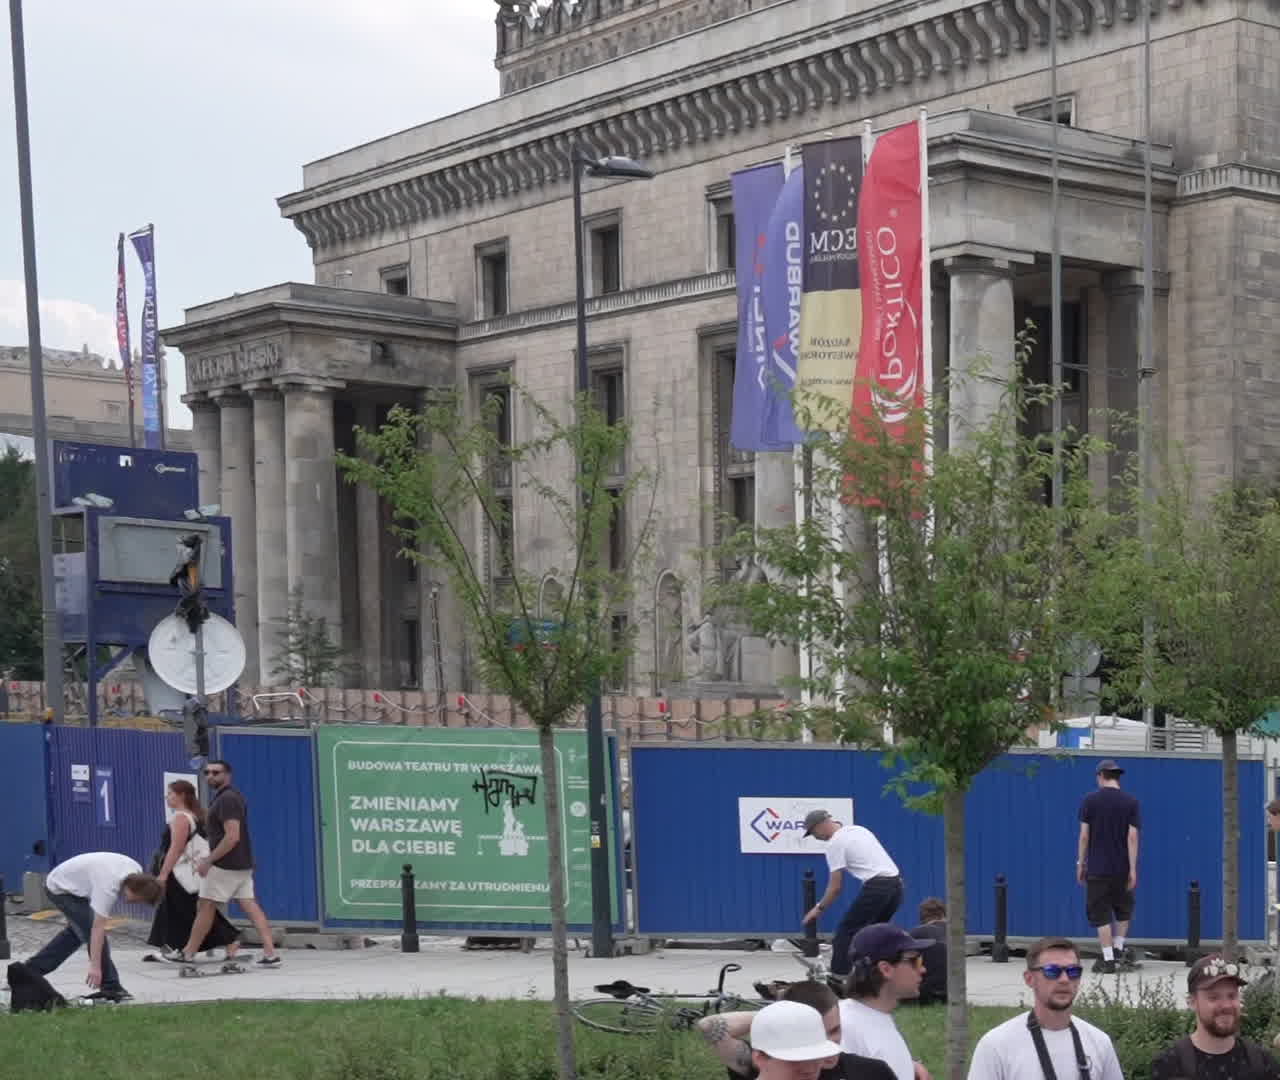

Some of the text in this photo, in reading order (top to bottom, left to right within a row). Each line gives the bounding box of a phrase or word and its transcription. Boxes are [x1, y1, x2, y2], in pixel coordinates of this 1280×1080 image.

[348, 760, 402, 772] BUDOWA
[403, 762, 450, 774] TEATRU
[453, 764, 468, 774] TR
[100, 780, 110, 822] 1
[350, 796, 460, 813] ZMIENIAMY
[350, 818, 463, 838] WARSZAWĘ
[351, 839, 456, 856] DLA CIEBIE
[450, 880, 466, 891] ZA
